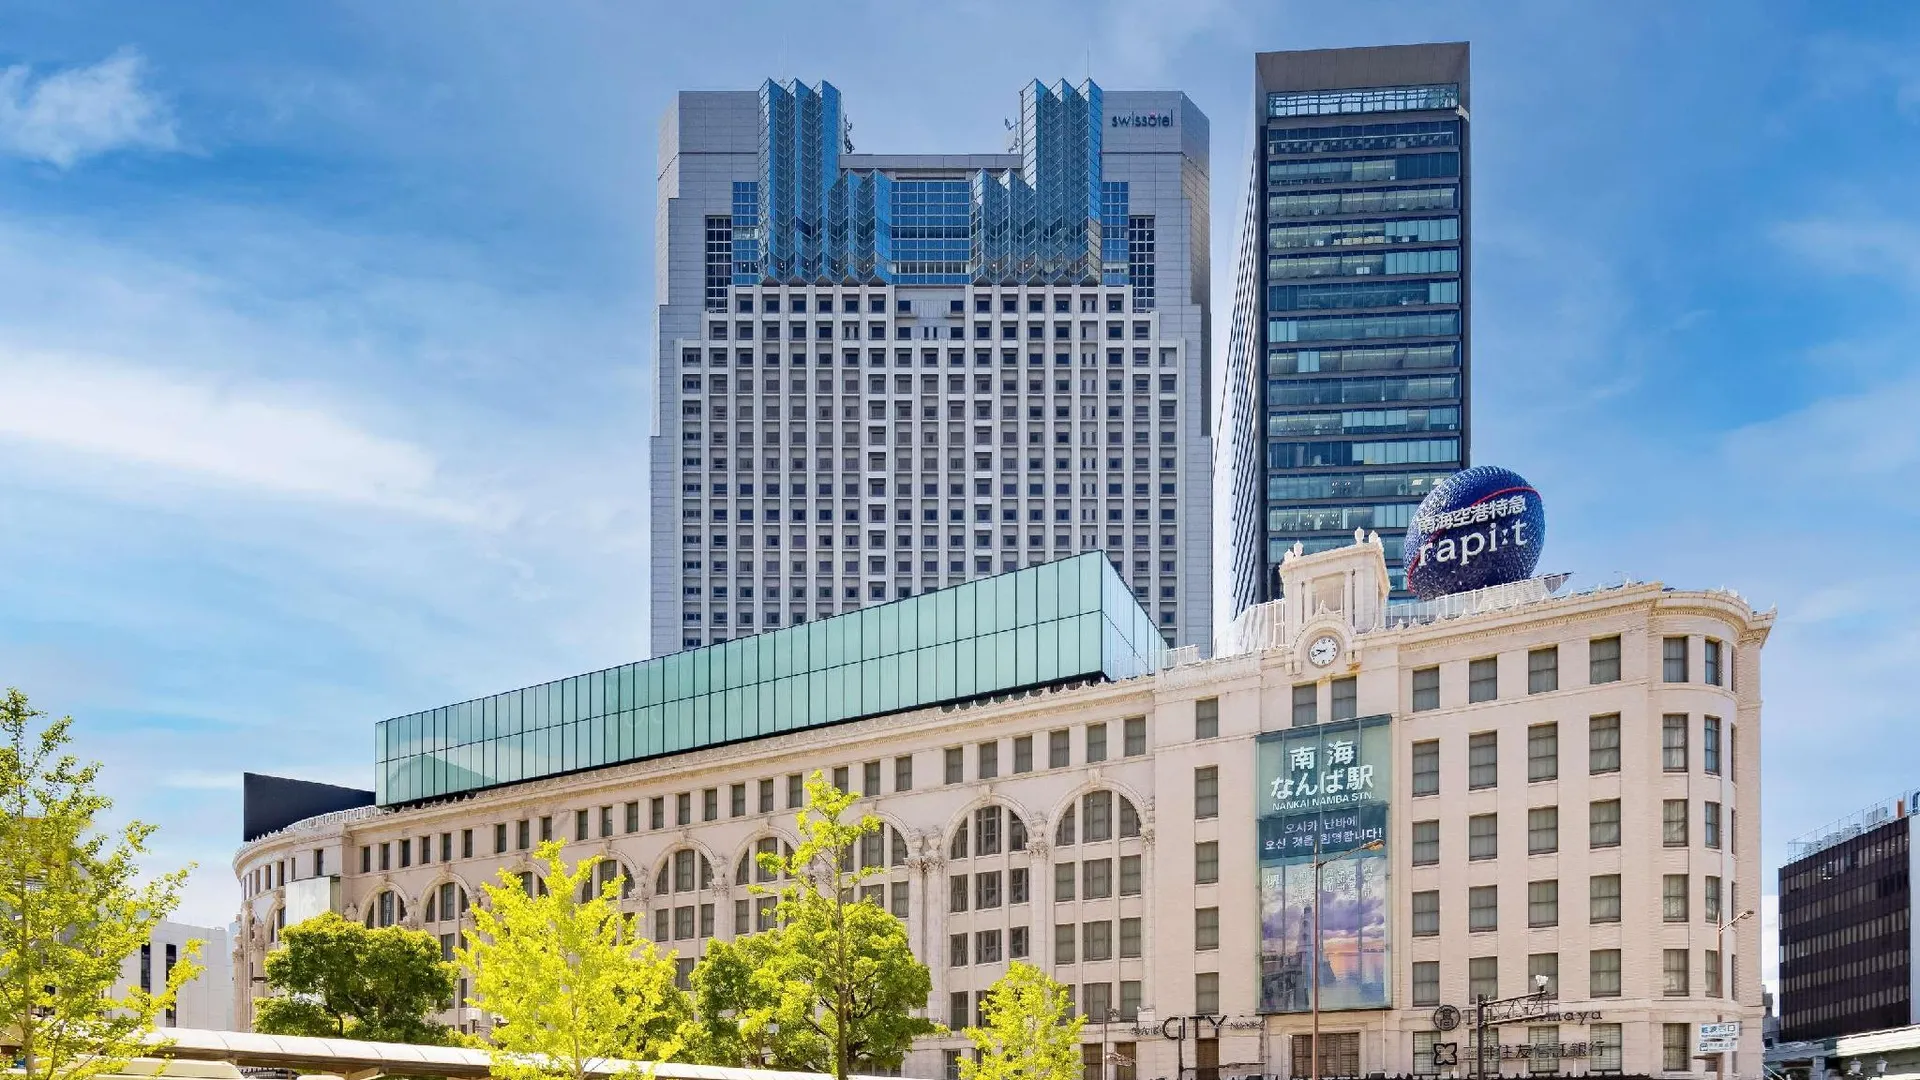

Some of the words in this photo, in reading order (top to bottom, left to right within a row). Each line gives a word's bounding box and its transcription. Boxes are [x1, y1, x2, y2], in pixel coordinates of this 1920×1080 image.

[1416, 495, 1527, 534] 南海空港特急
[1290, 740, 1354, 771] 南海
[1270, 765, 1374, 800] なんば駅
[1272, 800, 1310, 811] NANKAI
[1312, 795, 1349, 806] NAMBA
[1264, 838, 1286, 851] 오신
[1162, 1015, 1228, 1041] CITY
[1462, 1006, 1603, 1026] Tkahimaya
